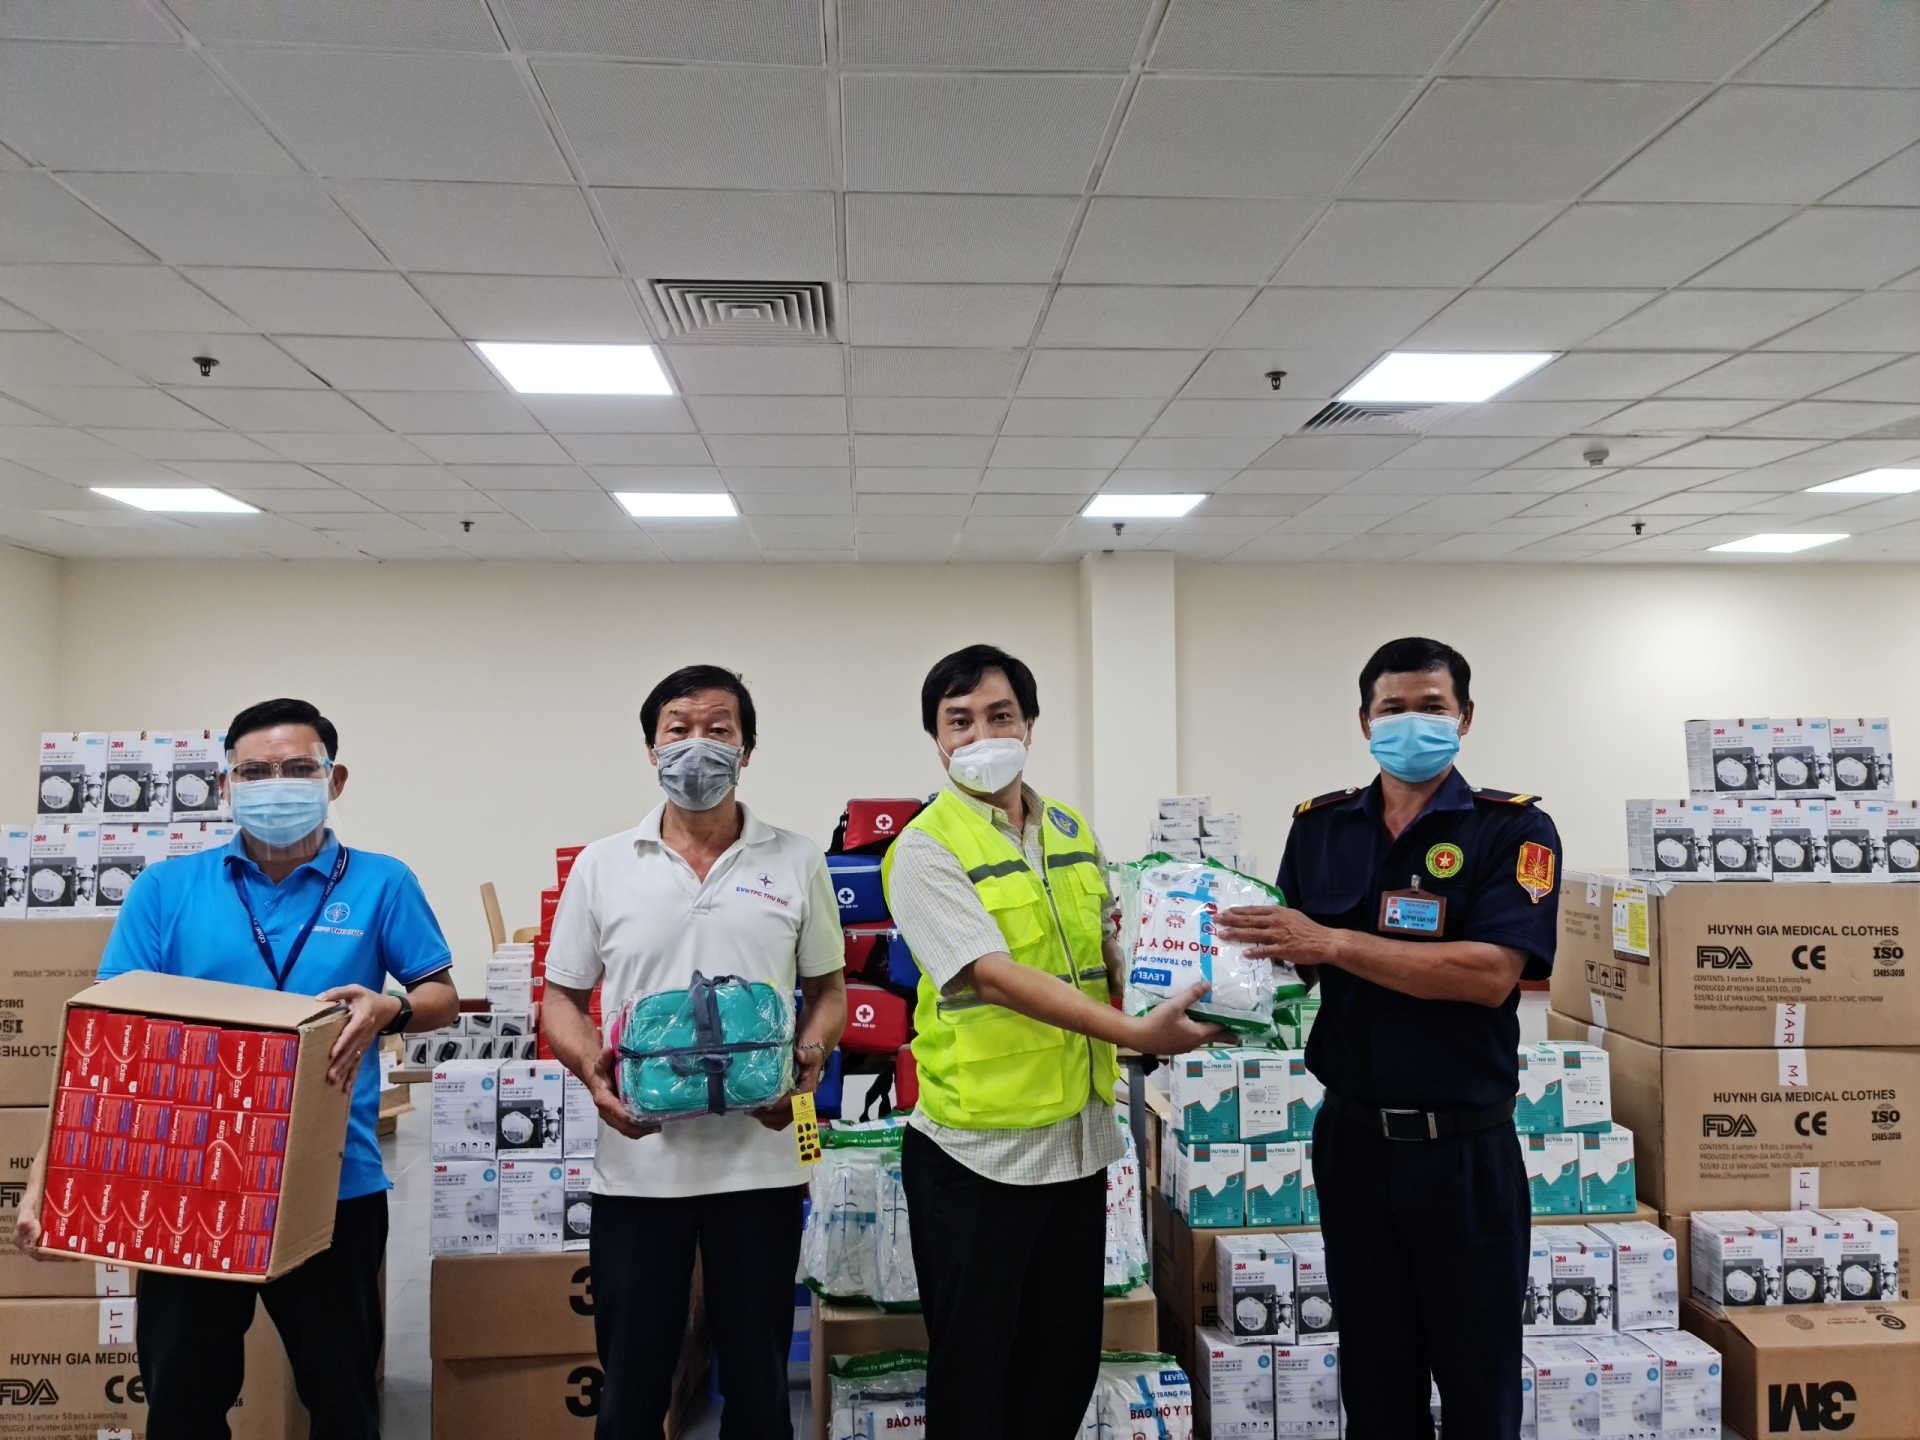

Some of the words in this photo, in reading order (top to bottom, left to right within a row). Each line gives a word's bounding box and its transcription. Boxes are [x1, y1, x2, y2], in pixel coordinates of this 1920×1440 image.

[43, 742, 56, 750] 3M
[111, 741, 124, 749] 3M
[175, 740, 188, 748] 3M
[763, 893, 776, 901] THU
[1708, 924, 1753, 936] HUYNH
[1757, 925, 1779, 936] GIA
[1782, 926, 1838, 936] MEDICAL
[1841, 926, 1899, 936] CLOTHES
[1149, 938, 1158, 947] Y
[1163, 937, 1184, 952] HỘ
[1189, 941, 1218, 956] BẢO
[1150, 956, 1179, 965] TRANG
[1697, 946, 1753, 969] FDA
[1792, 945, 1826, 970] CE
[1873, 946, 1904, 960] ISO
[1138, 971, 1164, 982] LEVEL
[1873, 969, 1905, 977] 13485:2016
[85, 1019, 95, 1050] Paralmax
[123, 1025, 132, 1056] Paralmax
[0, 1045, 57, 1057] CLOTHE
[236, 1041, 245, 1072] Paralmax
[81, 1057, 90, 1076] Extra
[119, 1064, 128, 1082] Extra
[233, 1080, 242, 1098] Extra
[1714, 1092, 1757, 1103] HUYNH
[1761, 1092, 1782, 1103] GIA
[1785, 1091, 1838, 1102] MEDICAL
[1842, 1089, 1896, 1100] CLOTHES
[1703, 1114, 1757, 1137] FDA
[1794, 1110, 1827, 1136] CE
[1871, 1110, 1900, 1123] ISO
[1871, 1132, 1901, 1141] 13485:2016
[211, 1148, 221, 1180] Paralmax
[217, 1120, 225, 1139] Extra
[64, 1178, 74, 1210] Paralmax
[101, 1185, 111, 1216] Paralmax
[139, 1190, 149, 1222] Paralmax
[177, 1196, 187, 1228] Paralmax
[216, 1201, 226, 1232] Paralmax
[59, 1217, 68, 1237] Extra
[97, 1224, 106, 1242] Extra
[135, 1230, 144, 1248] Extra
[173, 1235, 182, 1254] Extra
[212, 1240, 220, 1259] Extra
[10, 1353, 61, 1365] HUYNH
[66, 1353, 91, 1364] GIA
[1130, 1404, 1152, 1420] BẢO
[1156, 1404, 1171, 1419] HỘ
[1174, 1406, 1181, 1415] Y
[1768, 1380, 1856, 1432] 3M
[886, 1414, 910, 1428] BẢO
